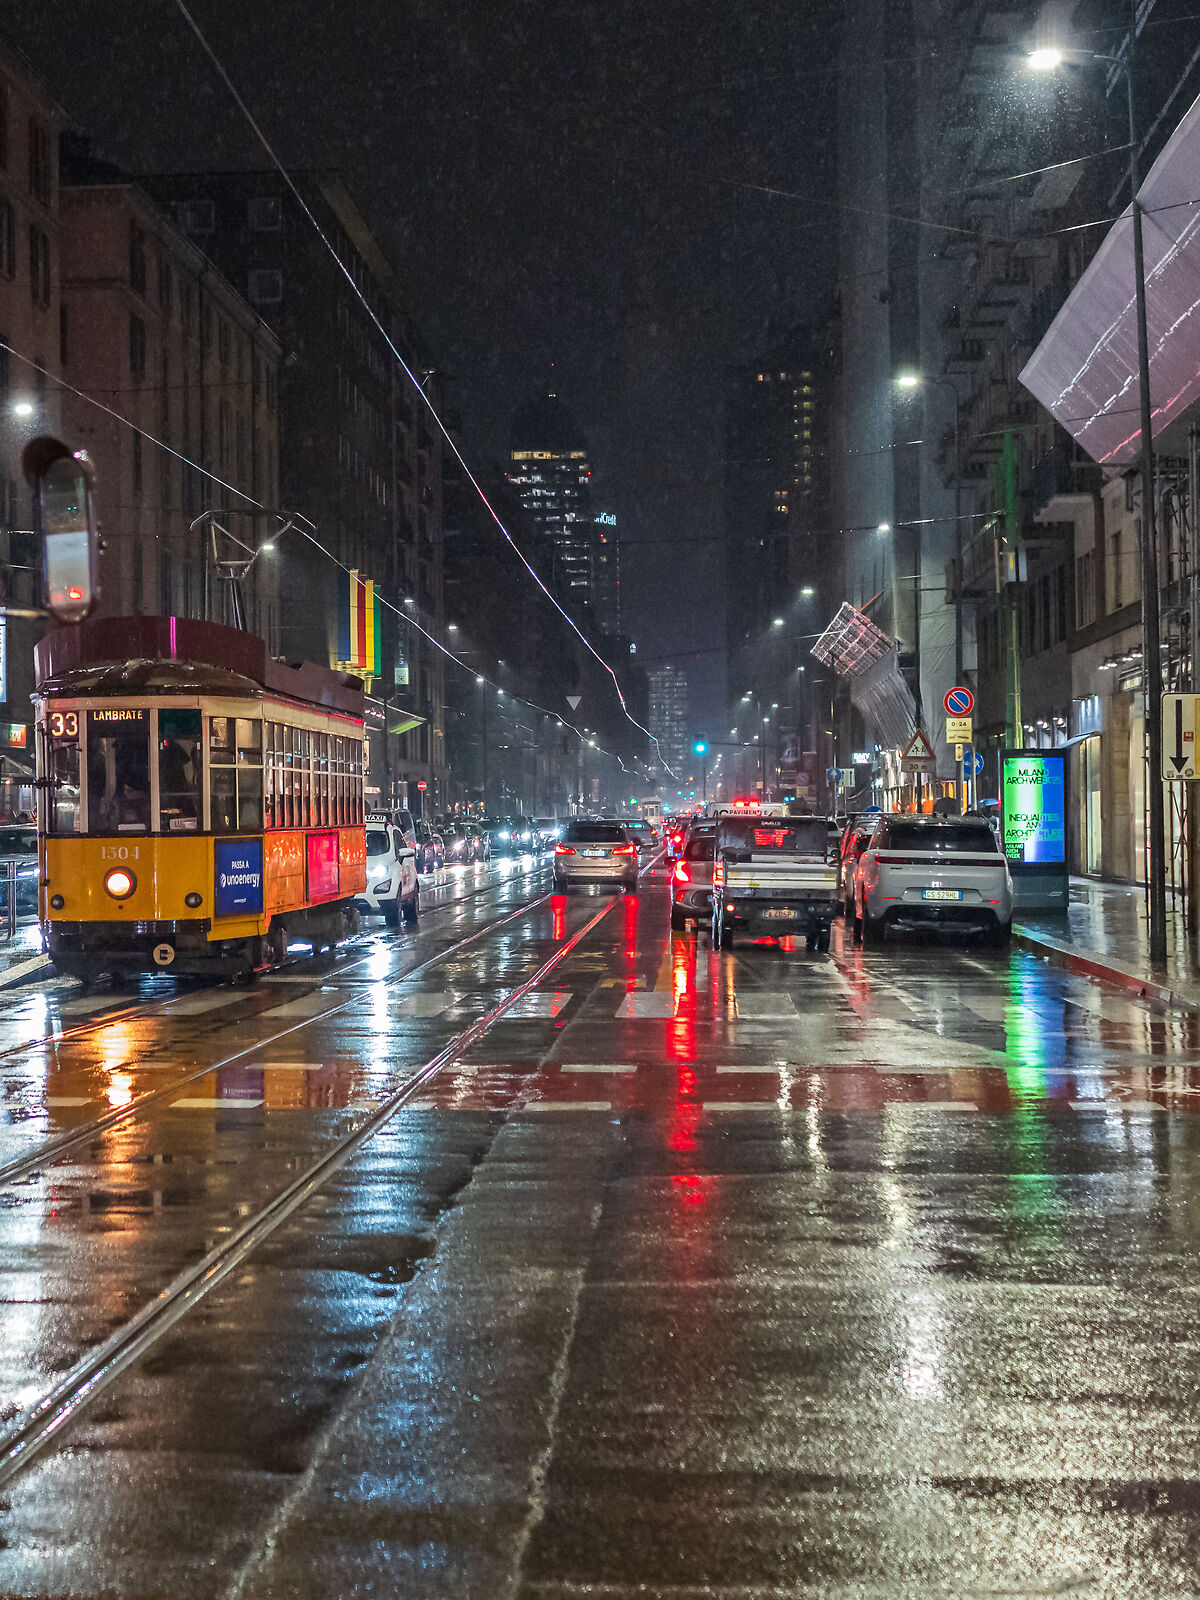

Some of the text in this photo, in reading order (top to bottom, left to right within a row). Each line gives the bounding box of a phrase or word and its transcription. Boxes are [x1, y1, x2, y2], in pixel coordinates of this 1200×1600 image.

[94, 709, 143, 721] LAMBRATE
[51, 712, 78, 736] 33
[1009, 813, 1059, 821] INEQUALITIES
[101, 846, 140, 860] 1504
[231, 860, 250, 870] PASSA A
[227, 873, 260, 888] unoenergy
